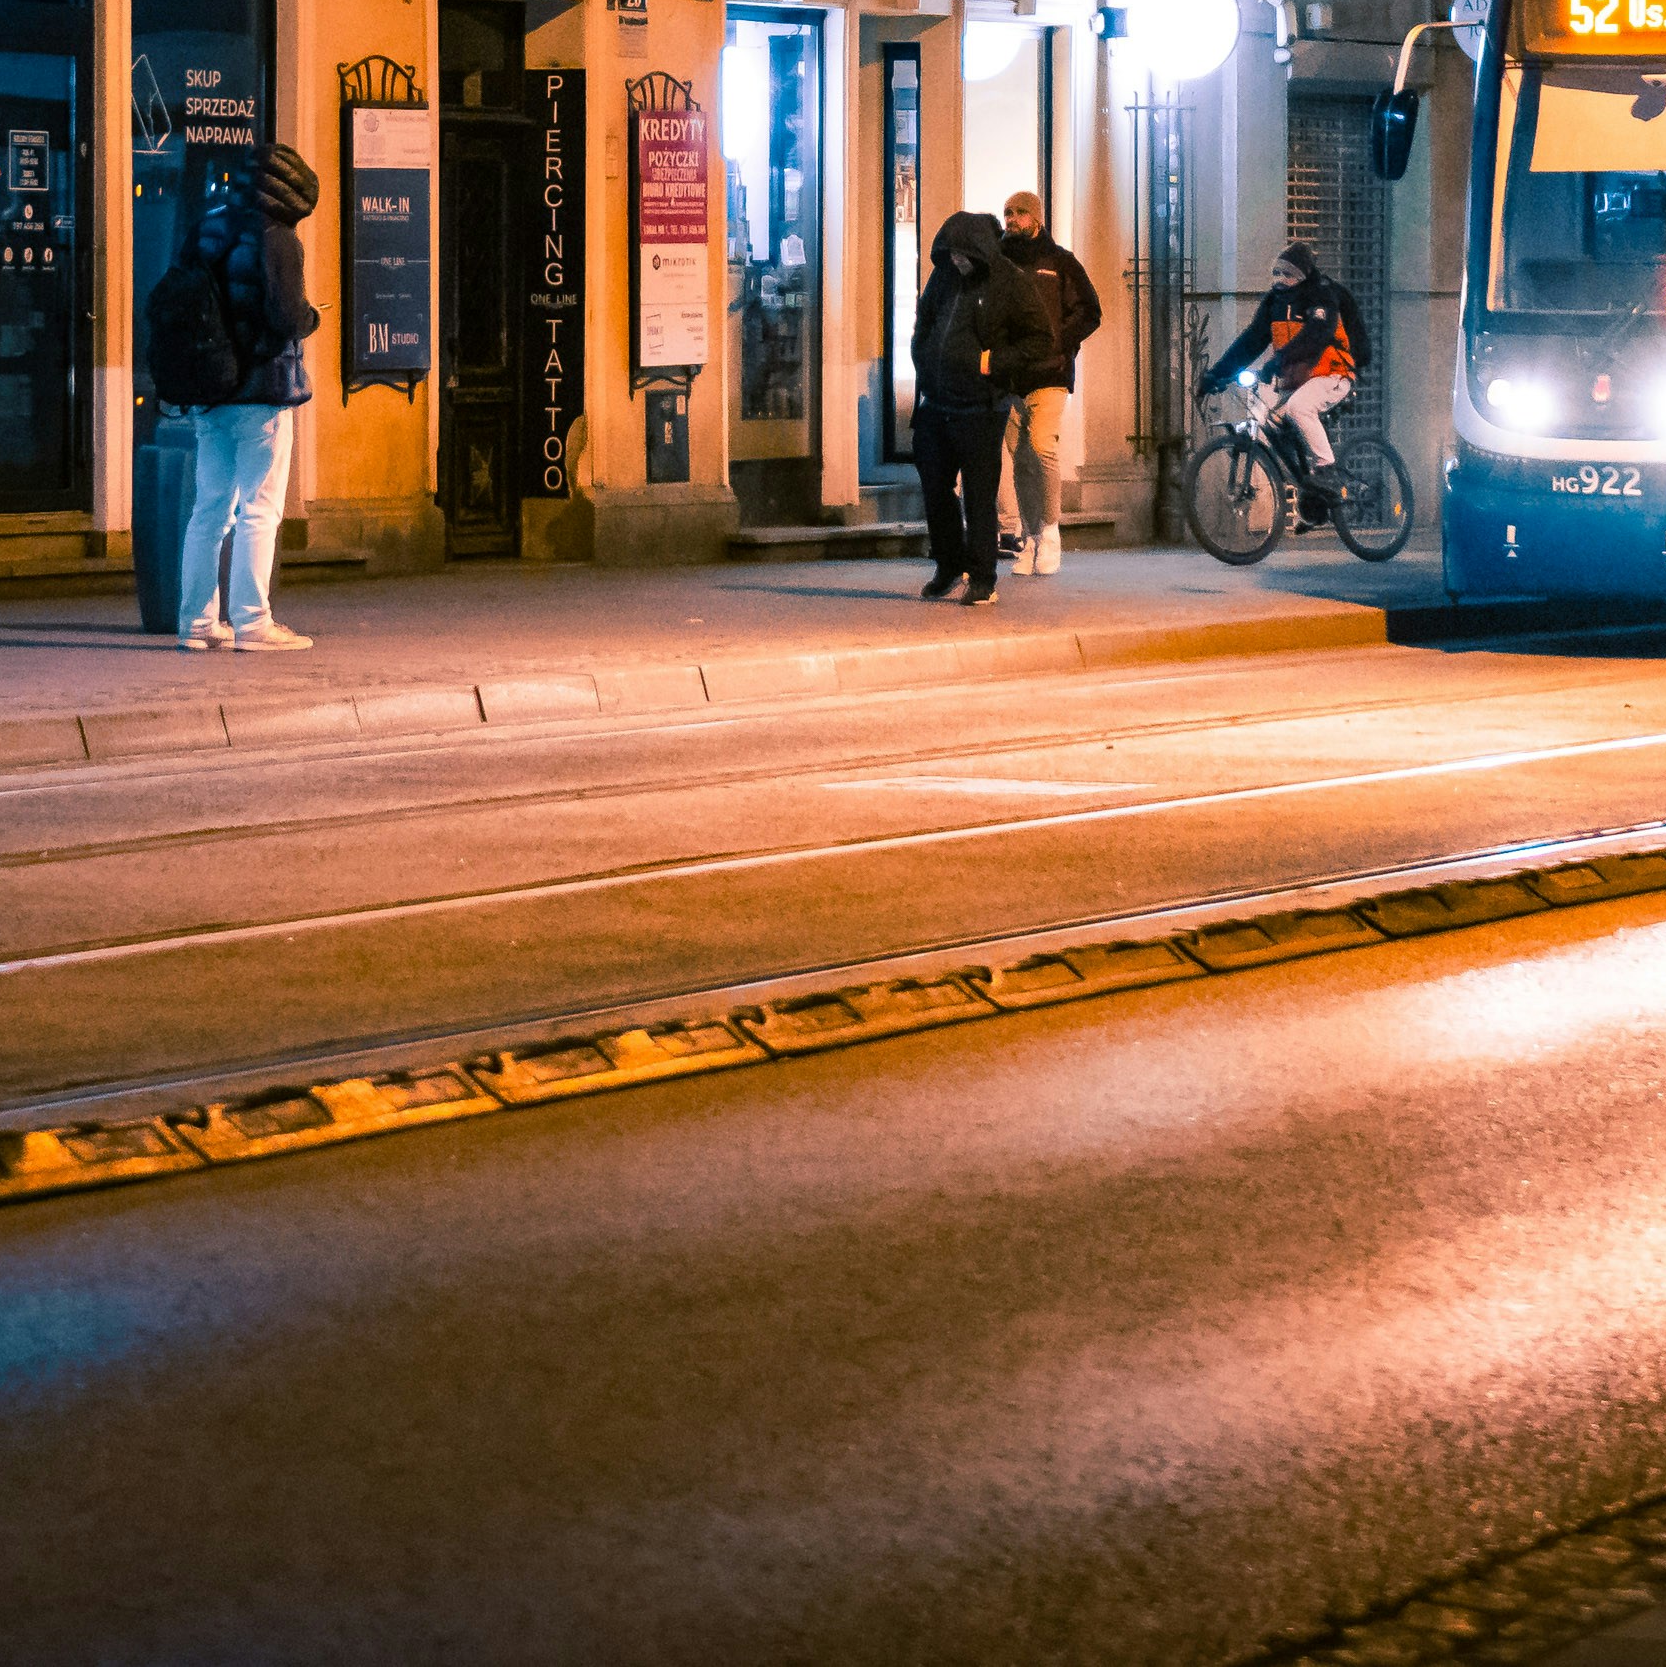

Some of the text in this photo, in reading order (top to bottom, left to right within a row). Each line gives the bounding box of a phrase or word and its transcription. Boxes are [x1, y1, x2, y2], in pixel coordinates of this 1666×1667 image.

[186, 69, 221, 88] SKUP
[186, 95, 255, 117] SPRZEDAŻ
[186, 126, 254, 145] NAPRAWA
[641, 118, 705, 141] KREDYTY
[648, 147, 699, 168] POŻYCZKI
[544, 75, 564, 286] PIERCING
[362, 197, 410, 213] WALK-IN
[531, 293, 578, 305] ONE LINE
[369, 323, 420, 353] BM STUDIO
[544, 319, 563, 491] TATTOO
[1552, 465, 1642, 496] HG922
